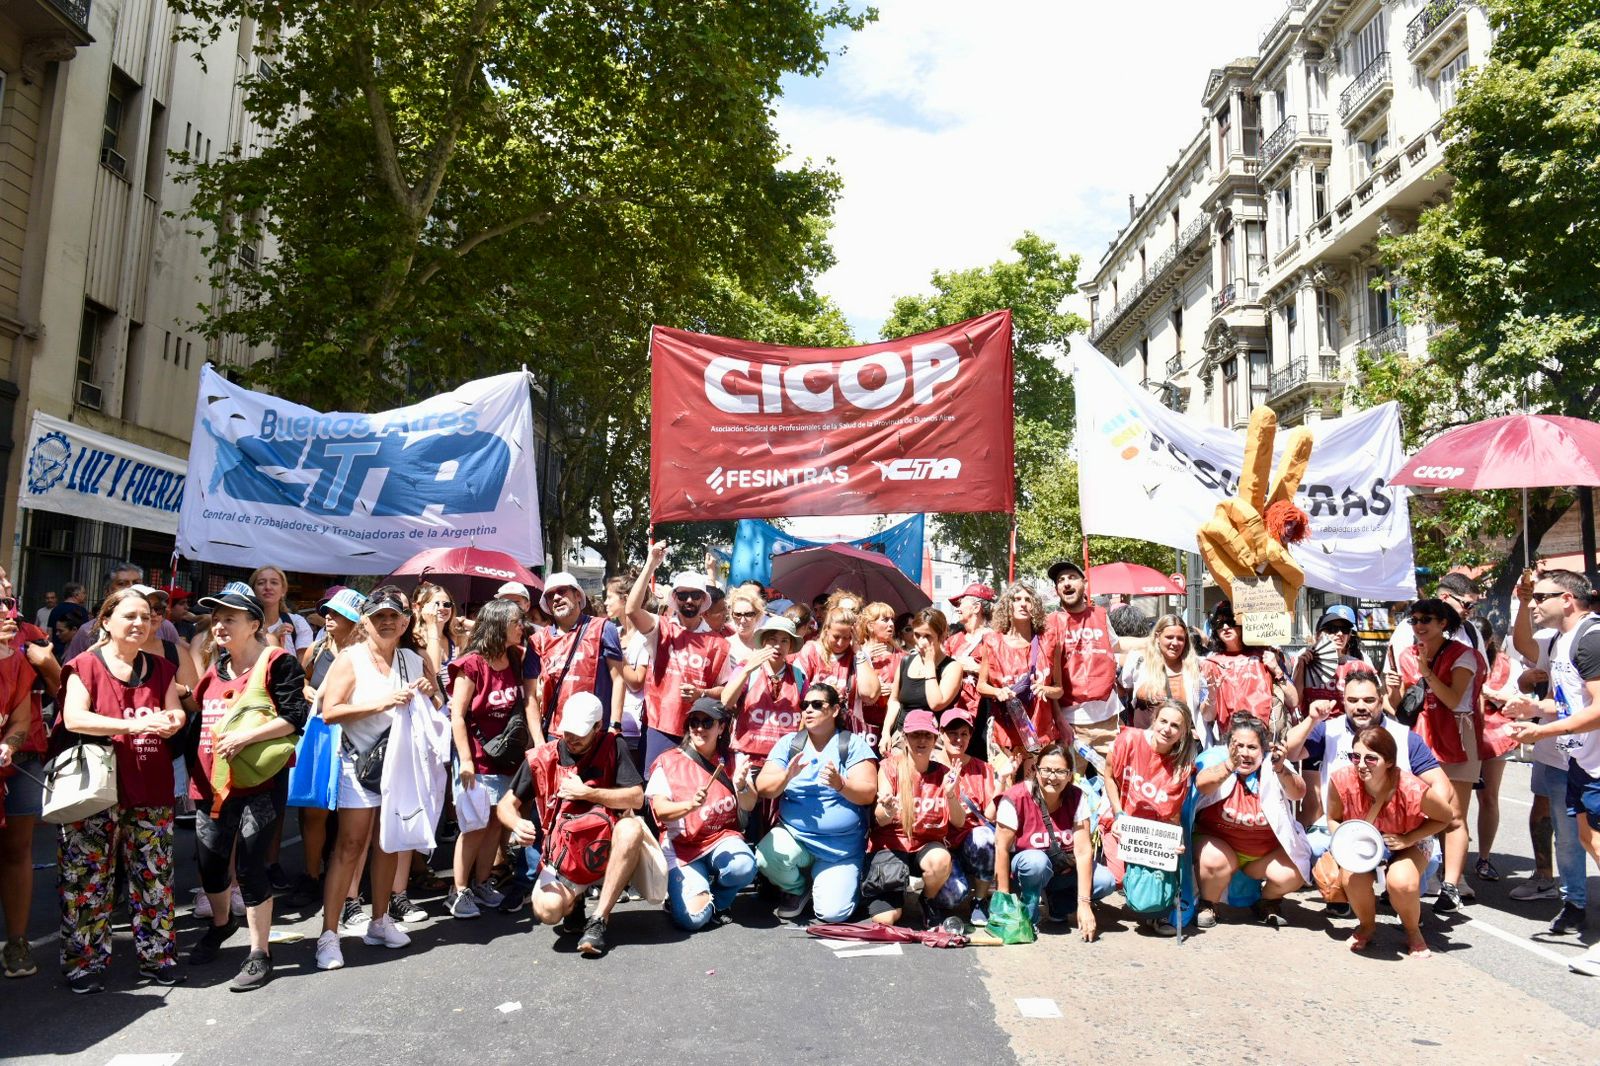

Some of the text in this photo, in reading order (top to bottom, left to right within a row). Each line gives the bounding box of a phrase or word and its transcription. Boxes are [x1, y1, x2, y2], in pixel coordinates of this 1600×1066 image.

[704, 342, 960, 414] CICOP
[261, 409, 482, 441] Buenos Aires
[711, 425, 744, 433] Asociación
[745, 424, 768, 433] Sindical
[779, 423, 822, 432] Profesionales
[822, 423, 832, 431] de
[839, 421, 857, 429] Salud
[939, 414, 956, 422] Aires
[66, 447, 186, 514] LUZ Y FUERZA
[224, 431, 512, 517] CTA
[726, 457, 962, 489] FESINTRAS CTA
[1413, 465, 1465, 480] CICOP
[202, 508, 497, 541] Central de Trabajadores y Trabajadoras de la Argentina
[475, 565, 517, 579] CICOP
[1245, 622, 1274, 632] REFORMA
[1256, 629, 1286, 639] LABORAL
[751, 708, 802, 728] CICOP
[1222, 807, 1268, 826] CICO
[1121, 823, 1179, 841] REFORMA LABORAL
[1120, 843, 1132, 852] TUS
[1134, 846, 1175, 860] DERECHOS
[1128, 838, 1163, 850] RECORTA
